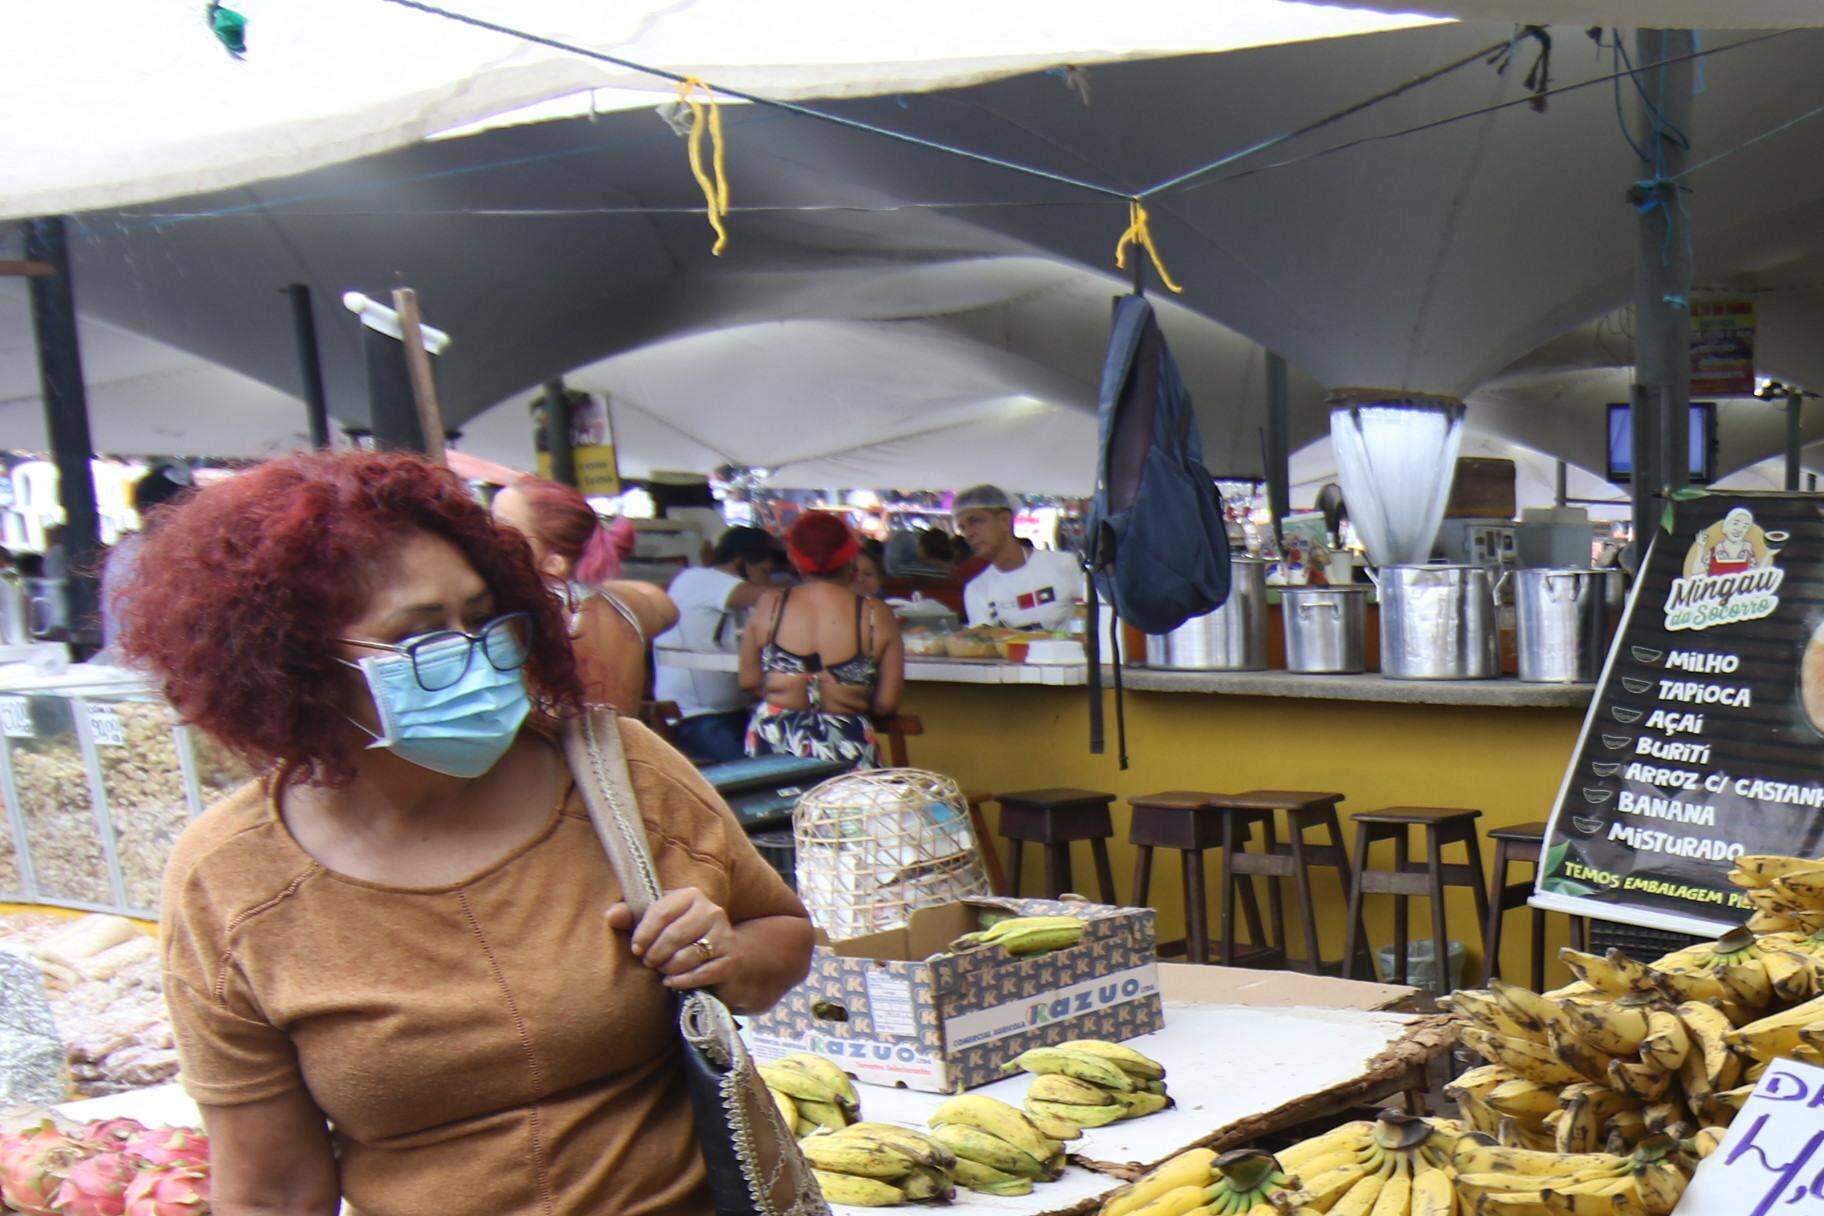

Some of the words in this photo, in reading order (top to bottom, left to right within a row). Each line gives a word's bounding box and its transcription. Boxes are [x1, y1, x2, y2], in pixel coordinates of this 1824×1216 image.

[1671, 570, 1777, 606] Mingau
[1671, 610, 1690, 626] da
[1694, 599, 1769, 625] Socorro
[1624, 762, 1699, 790] ARROZ
[1704, 775, 1731, 794] C/
[1617, 791, 1716, 827] BANANA
[1564, 861, 1621, 889] TEMOS
[1623, 876, 1723, 906] EMBALAGEM
